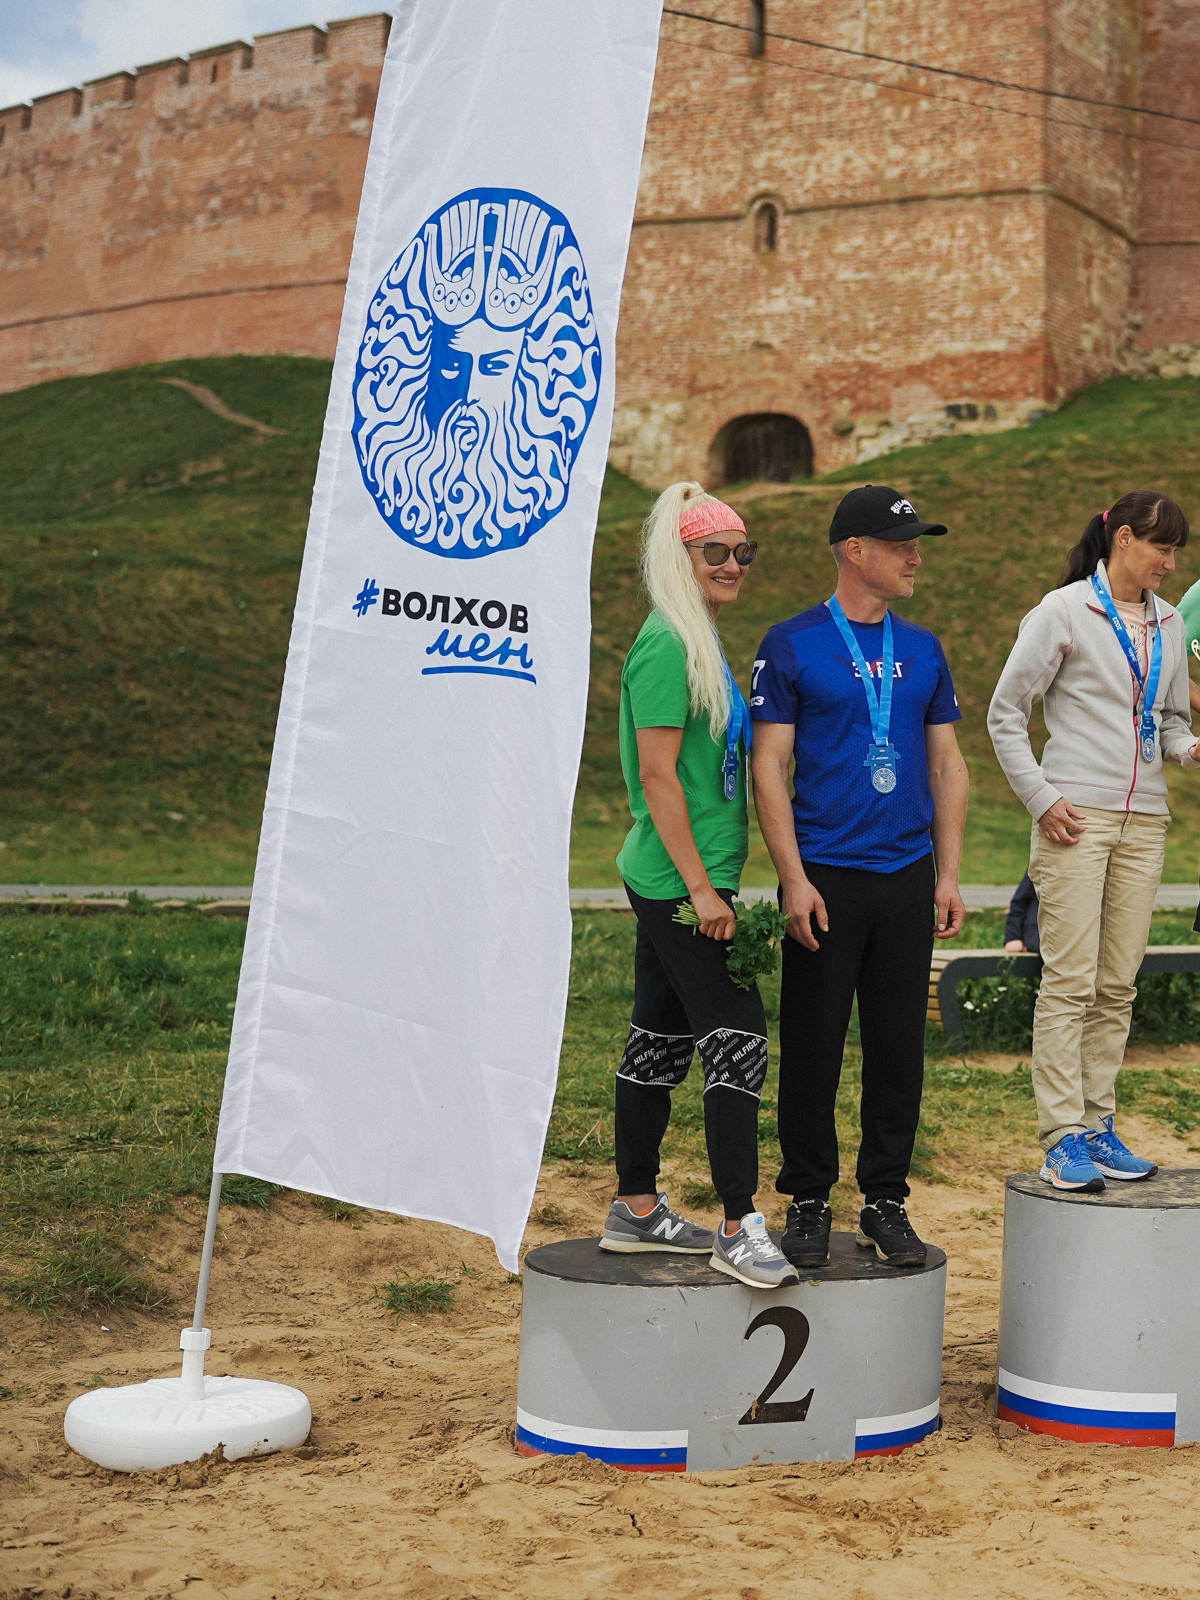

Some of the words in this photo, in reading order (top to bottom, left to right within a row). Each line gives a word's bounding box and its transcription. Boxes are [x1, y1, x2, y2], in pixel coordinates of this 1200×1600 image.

[352, 578, 528, 633] #ВОЛХОВ
[425, 628, 534, 669] мен
[738, 1306, 815, 1426] 2
